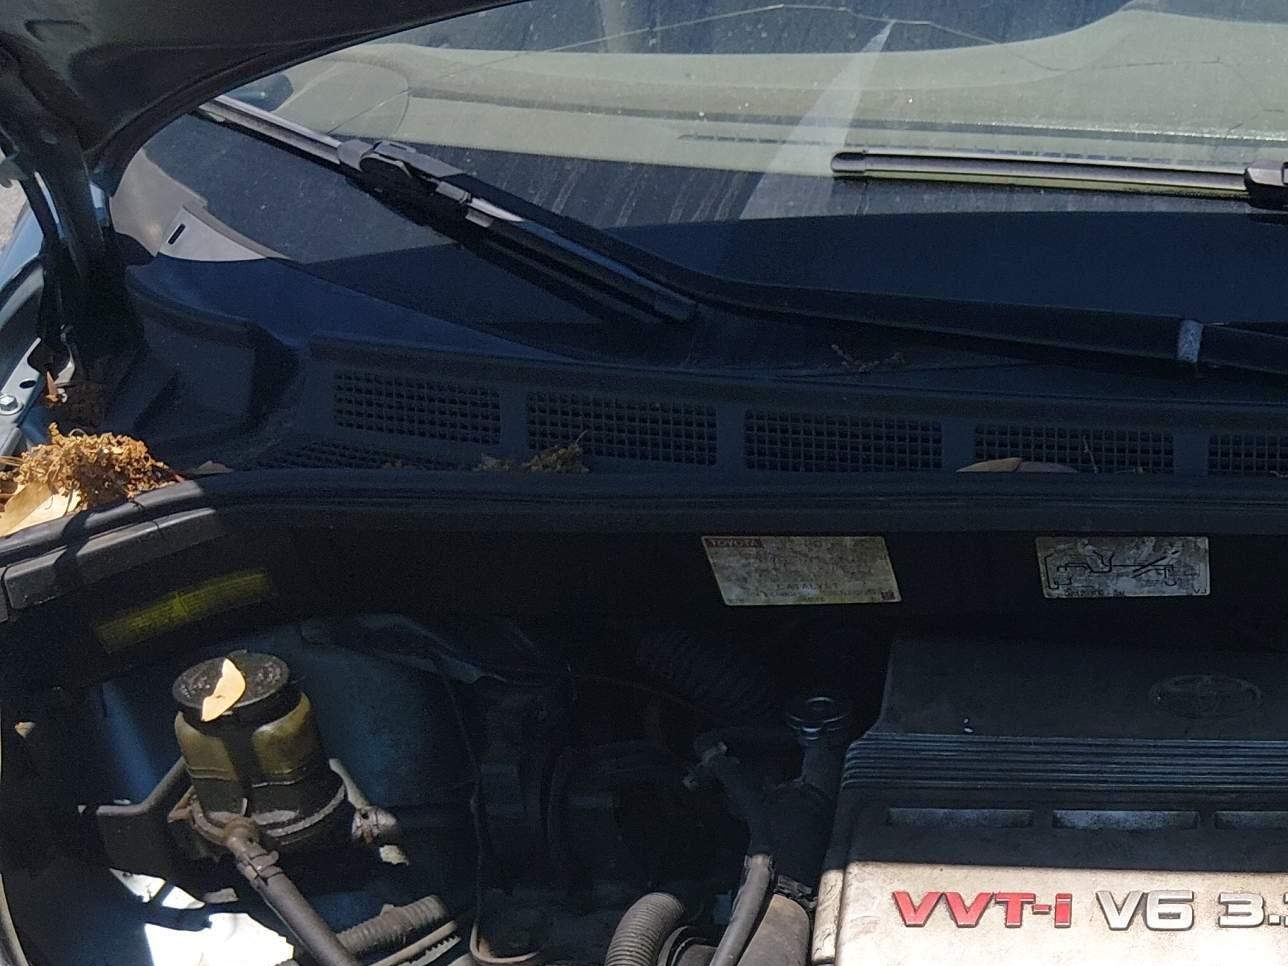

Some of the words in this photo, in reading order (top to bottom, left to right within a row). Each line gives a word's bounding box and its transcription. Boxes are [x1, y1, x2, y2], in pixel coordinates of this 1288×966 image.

[711, 538, 761, 547] TOYOTA
[892, 890, 1073, 929] VVT-i
[1095, 889, 1196, 932] V6
